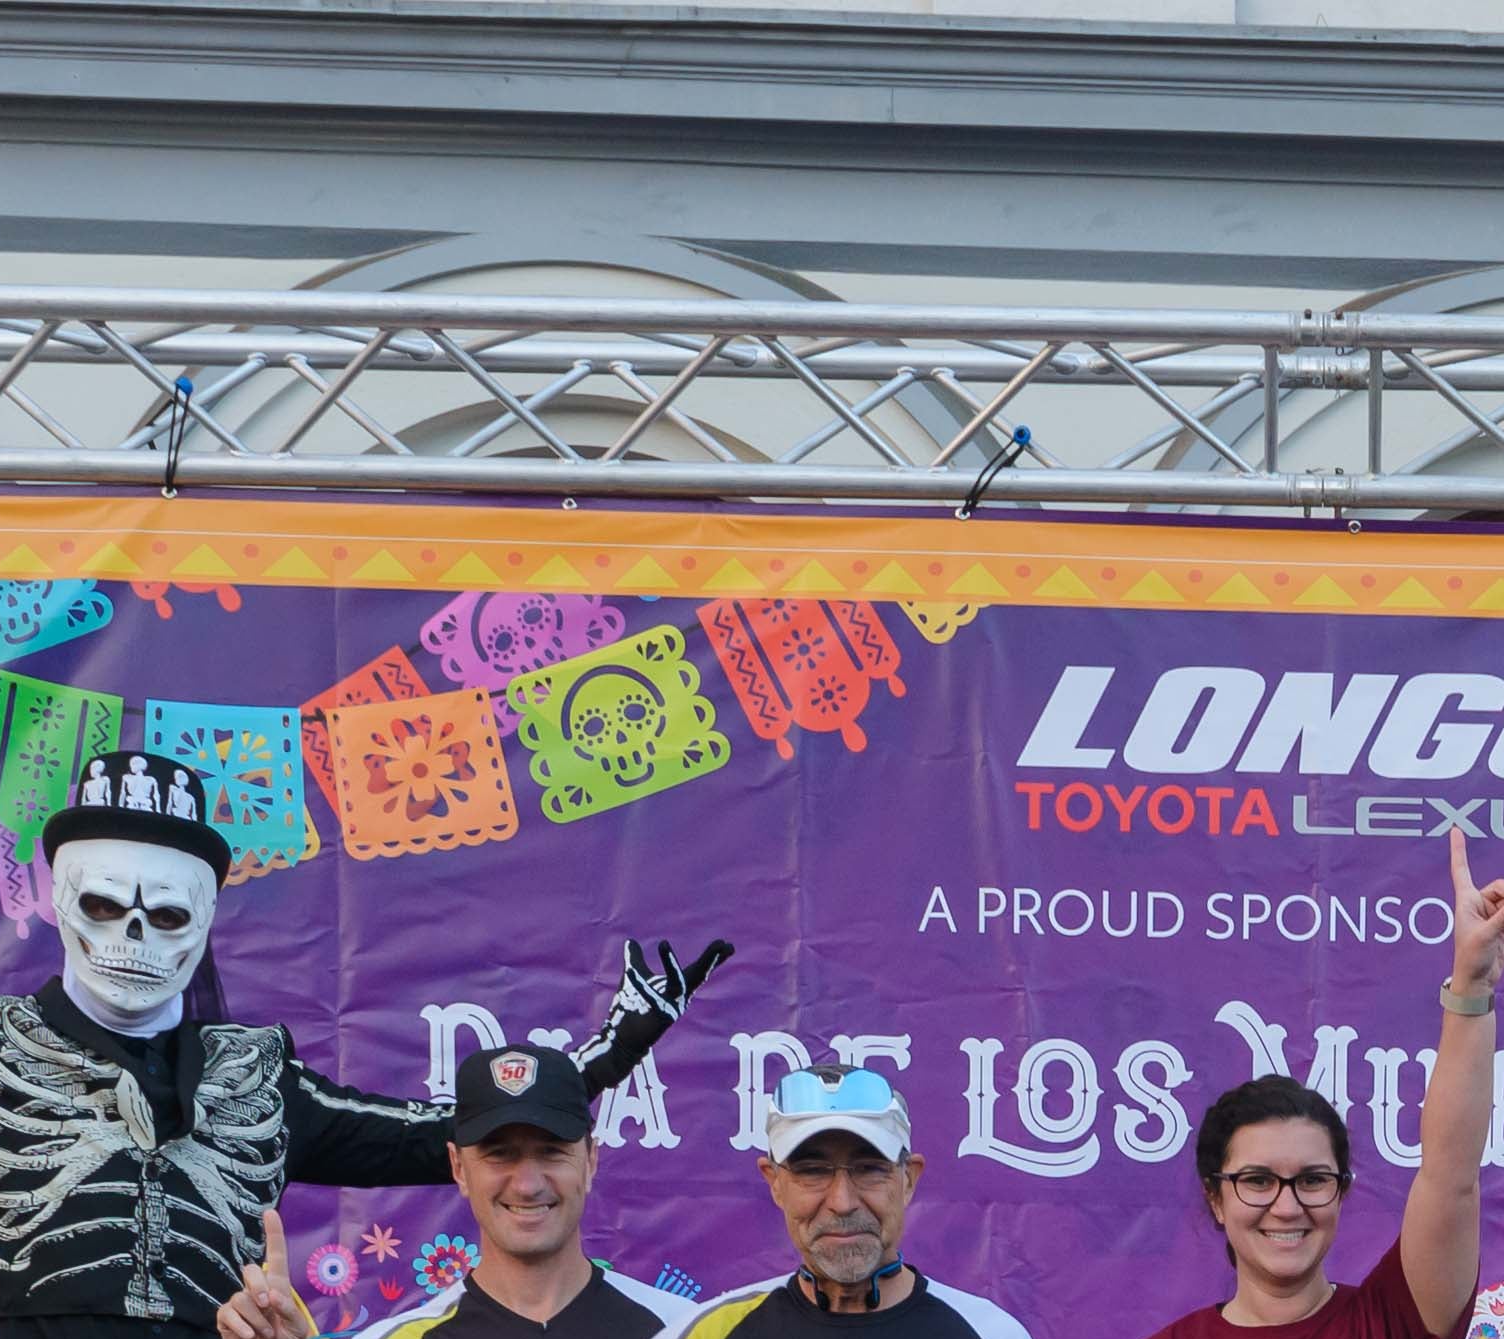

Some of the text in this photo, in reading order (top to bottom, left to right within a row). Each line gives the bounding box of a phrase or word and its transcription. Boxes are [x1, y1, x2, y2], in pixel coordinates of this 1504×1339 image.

[1015, 781, 1280, 837] TOYOTA
[918, 886, 957, 932] A
[978, 887, 1185, 938] PROUD
[1205, 893, 1456, 943] SPONSO
[419, 1002, 681, 1150] DA
[957, 1036, 1194, 1179] LOS
